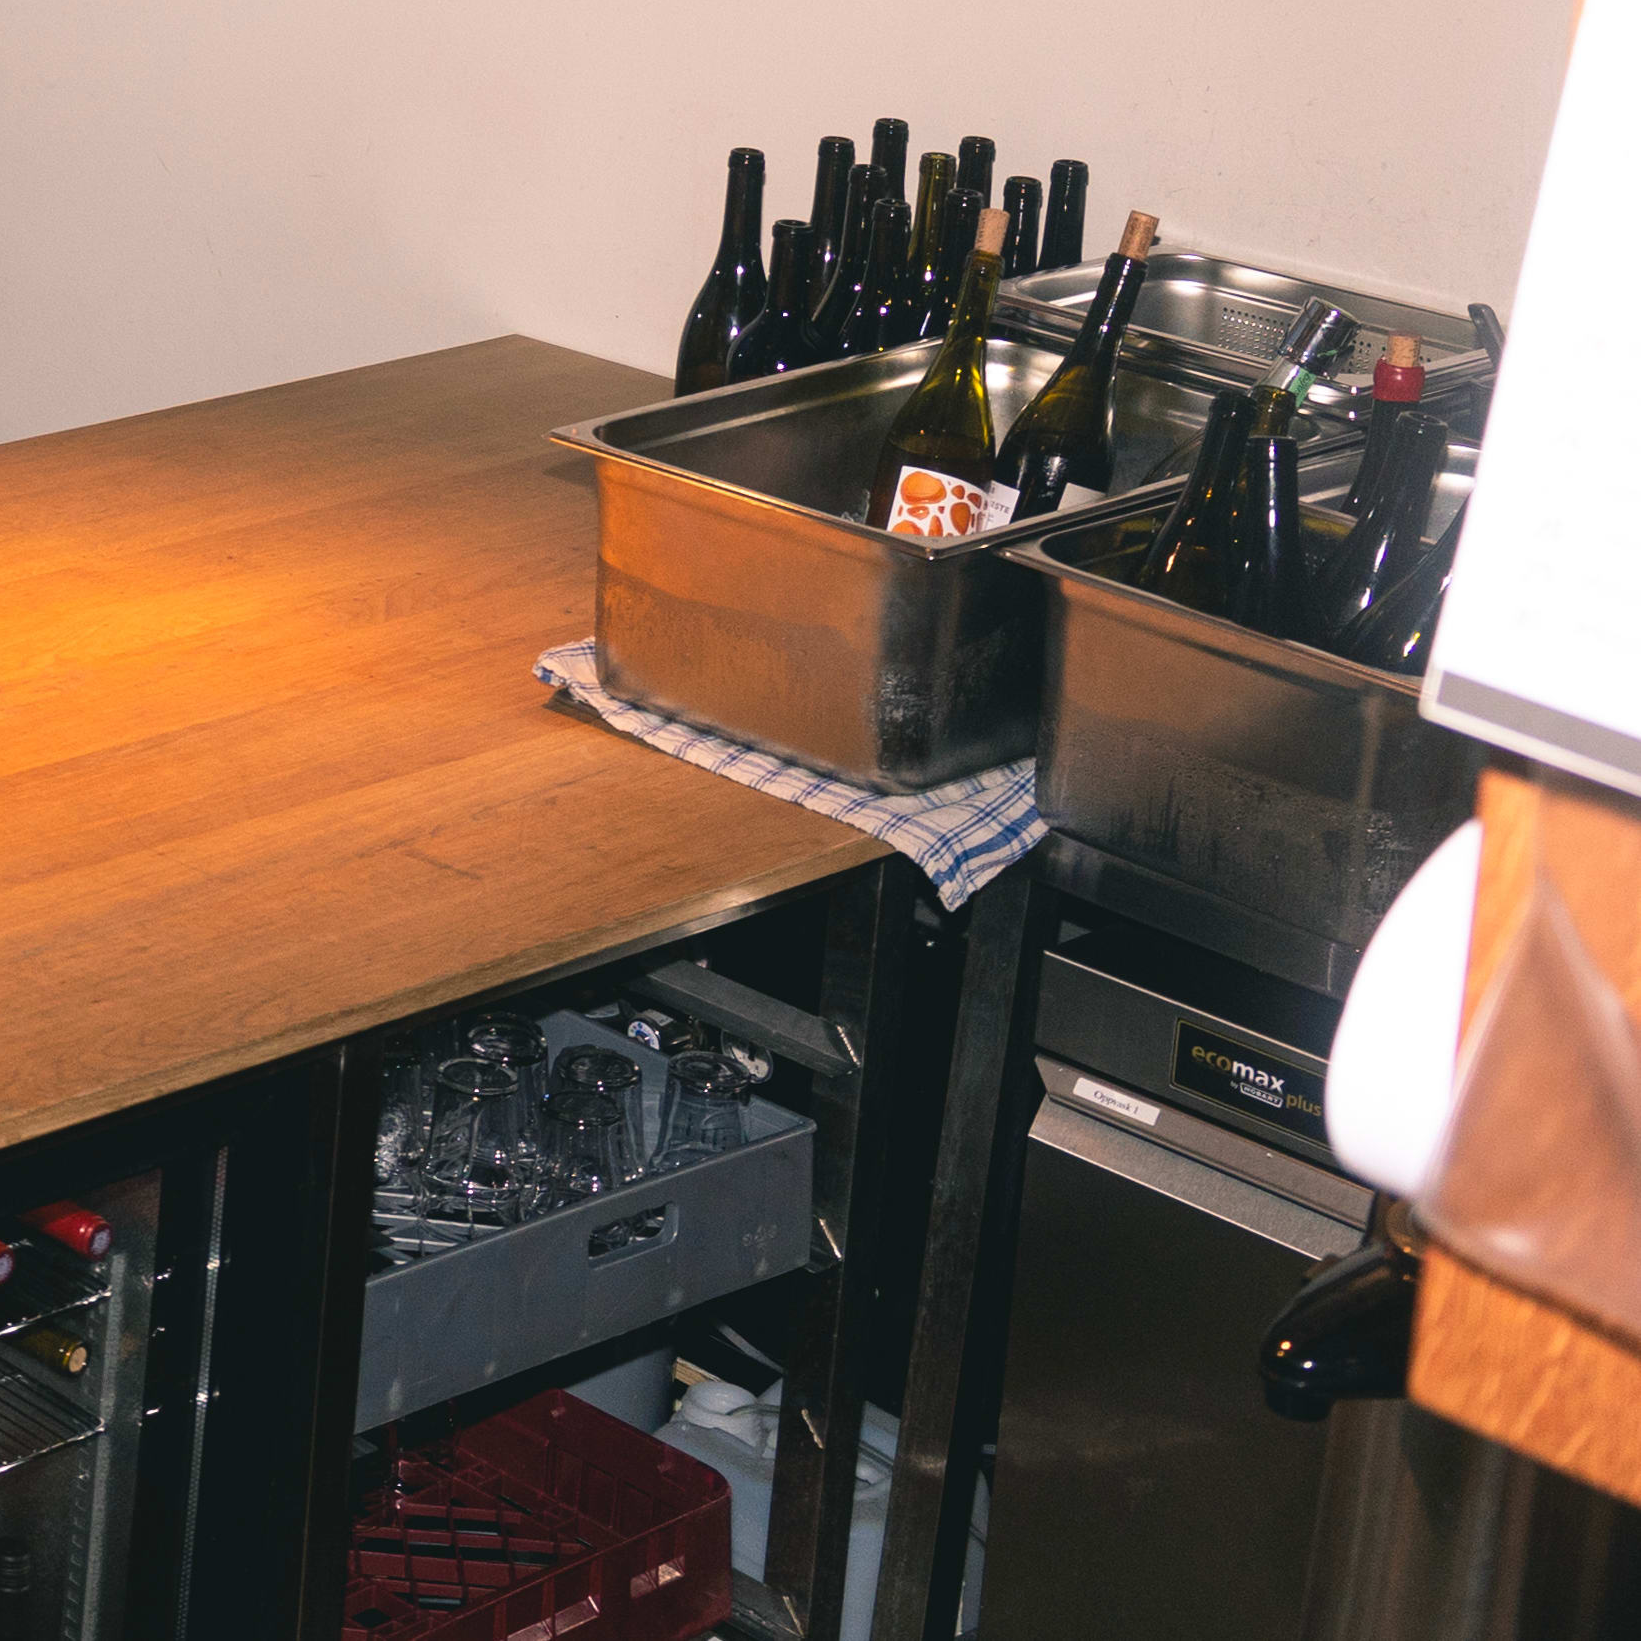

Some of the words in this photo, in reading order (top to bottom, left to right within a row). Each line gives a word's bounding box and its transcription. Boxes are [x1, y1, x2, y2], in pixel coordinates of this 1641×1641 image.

[1191, 1045, 1285, 1094] ecomax
[1093, 1090, 1132, 1111] Oppvask
[1242, 1085, 1281, 1105] HOBART
[1285, 1093, 1323, 1117] plus
